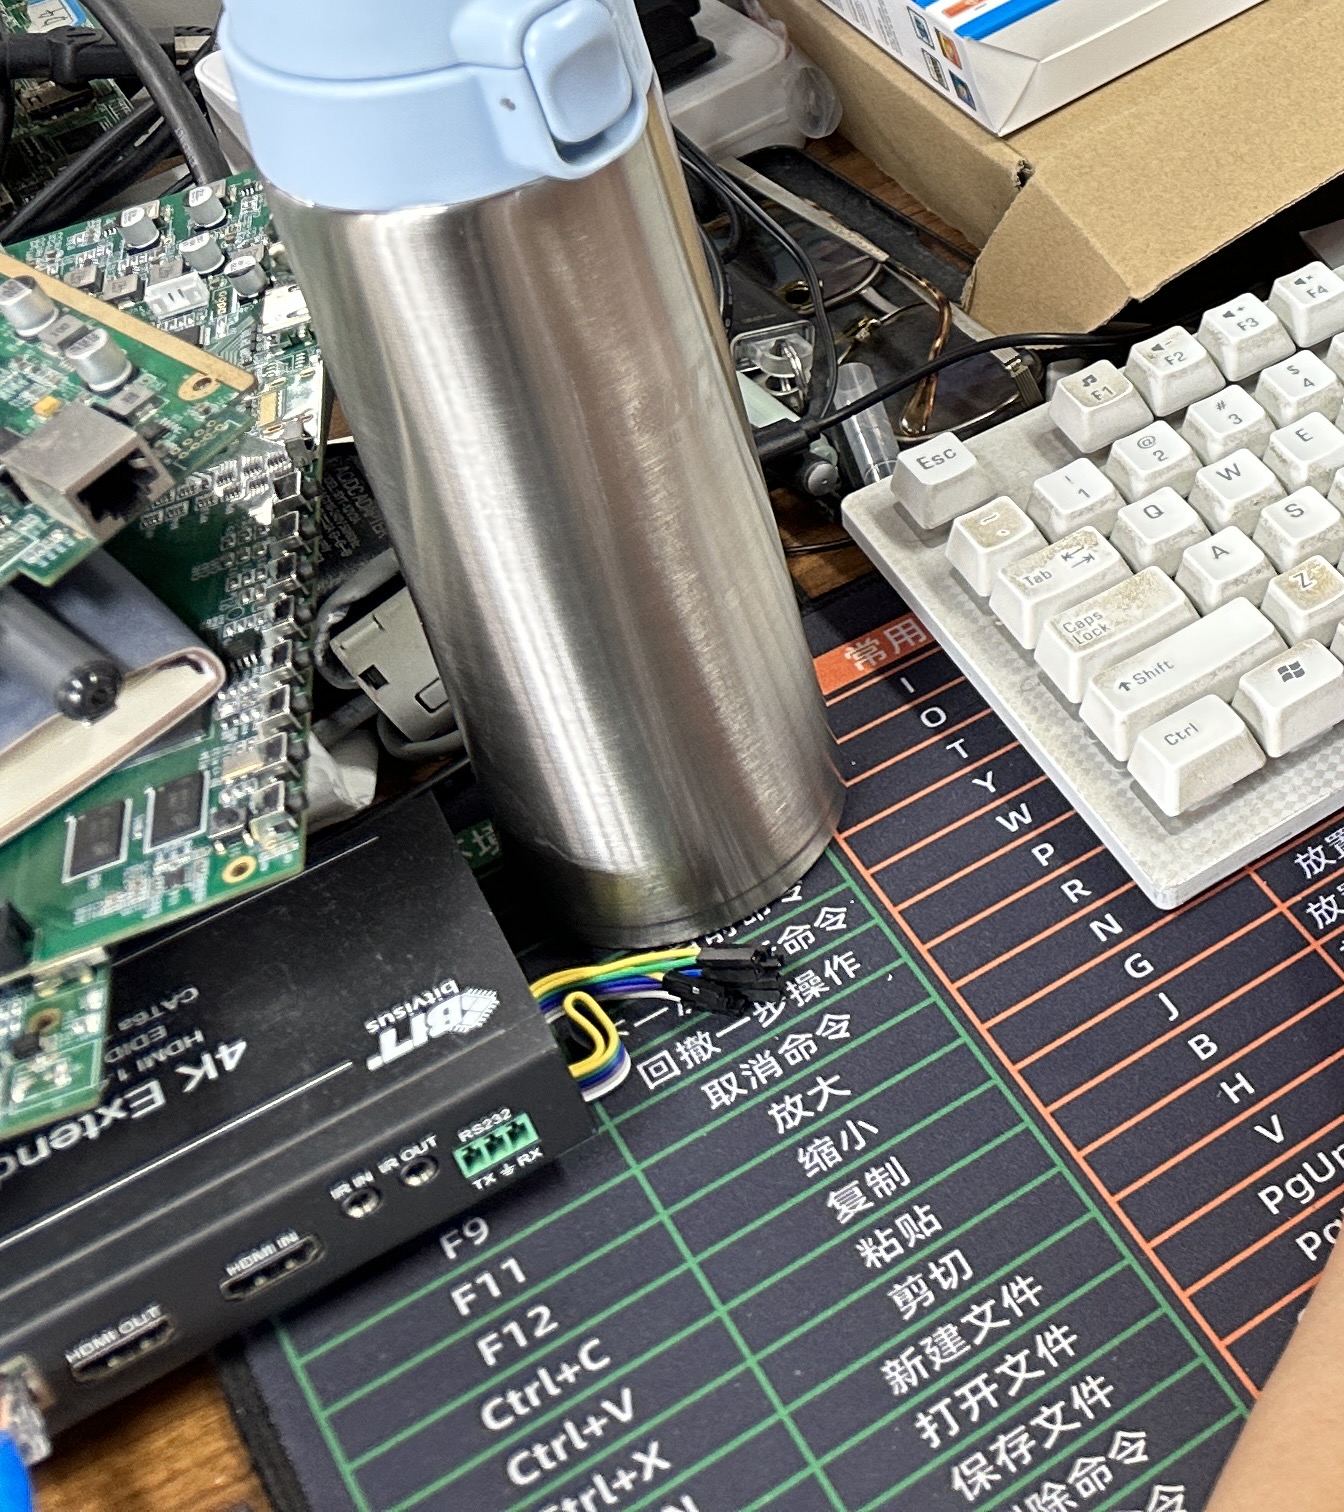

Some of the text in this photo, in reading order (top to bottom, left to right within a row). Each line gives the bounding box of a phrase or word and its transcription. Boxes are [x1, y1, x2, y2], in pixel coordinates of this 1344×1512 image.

[915, 444, 958, 472] Esc
[1023, 565, 1053, 589] Tab
[1062, 608, 1104, 636] Caps
[1072, 621, 1109, 646] Lock
[1133, 656, 1176, 686] Shift
[1162, 721, 1200, 748] Ctrl
[1089, 913, 1123, 944] N
[363, 977, 459, 1034] bitvisus
[173, 1037, 249, 1093] 4K
[701, 1010, 852, 1111] 取消命令
[1188, 1033, 1219, 1060] B
[457, 1107, 512, 1143] RS232
[767, 1072, 852, 1134] 放大
[378, 1133, 440, 1175] IR OUT
[516, 1146, 544, 1168] RX
[796, 1116, 879, 1178] 缩小
[330, 1170, 374, 1201] IR IN
[471, 1171, 497, 1192] TX
[826, 1155, 911, 1224] 复制
[225, 1229, 299, 1277] HDMI IN
[439, 1216, 491, 1260] F9
[855, 1202, 942, 1271] 粘贴
[451, 1257, 528, 1317] F11
[887, 1250, 974, 1322] 剪切
[64, 1324, 119, 1366] HDMI
[475, 1304, 559, 1367] F12
[880, 1270, 1044, 1397] 新建文件
[480, 1337, 611, 1432] Ctrl+C
[914, 1322, 1078, 1449] 打开文件
[506, 1388, 637, 1487] Ctrl+V
[949, 1372, 1115, 1503] 保存文件
